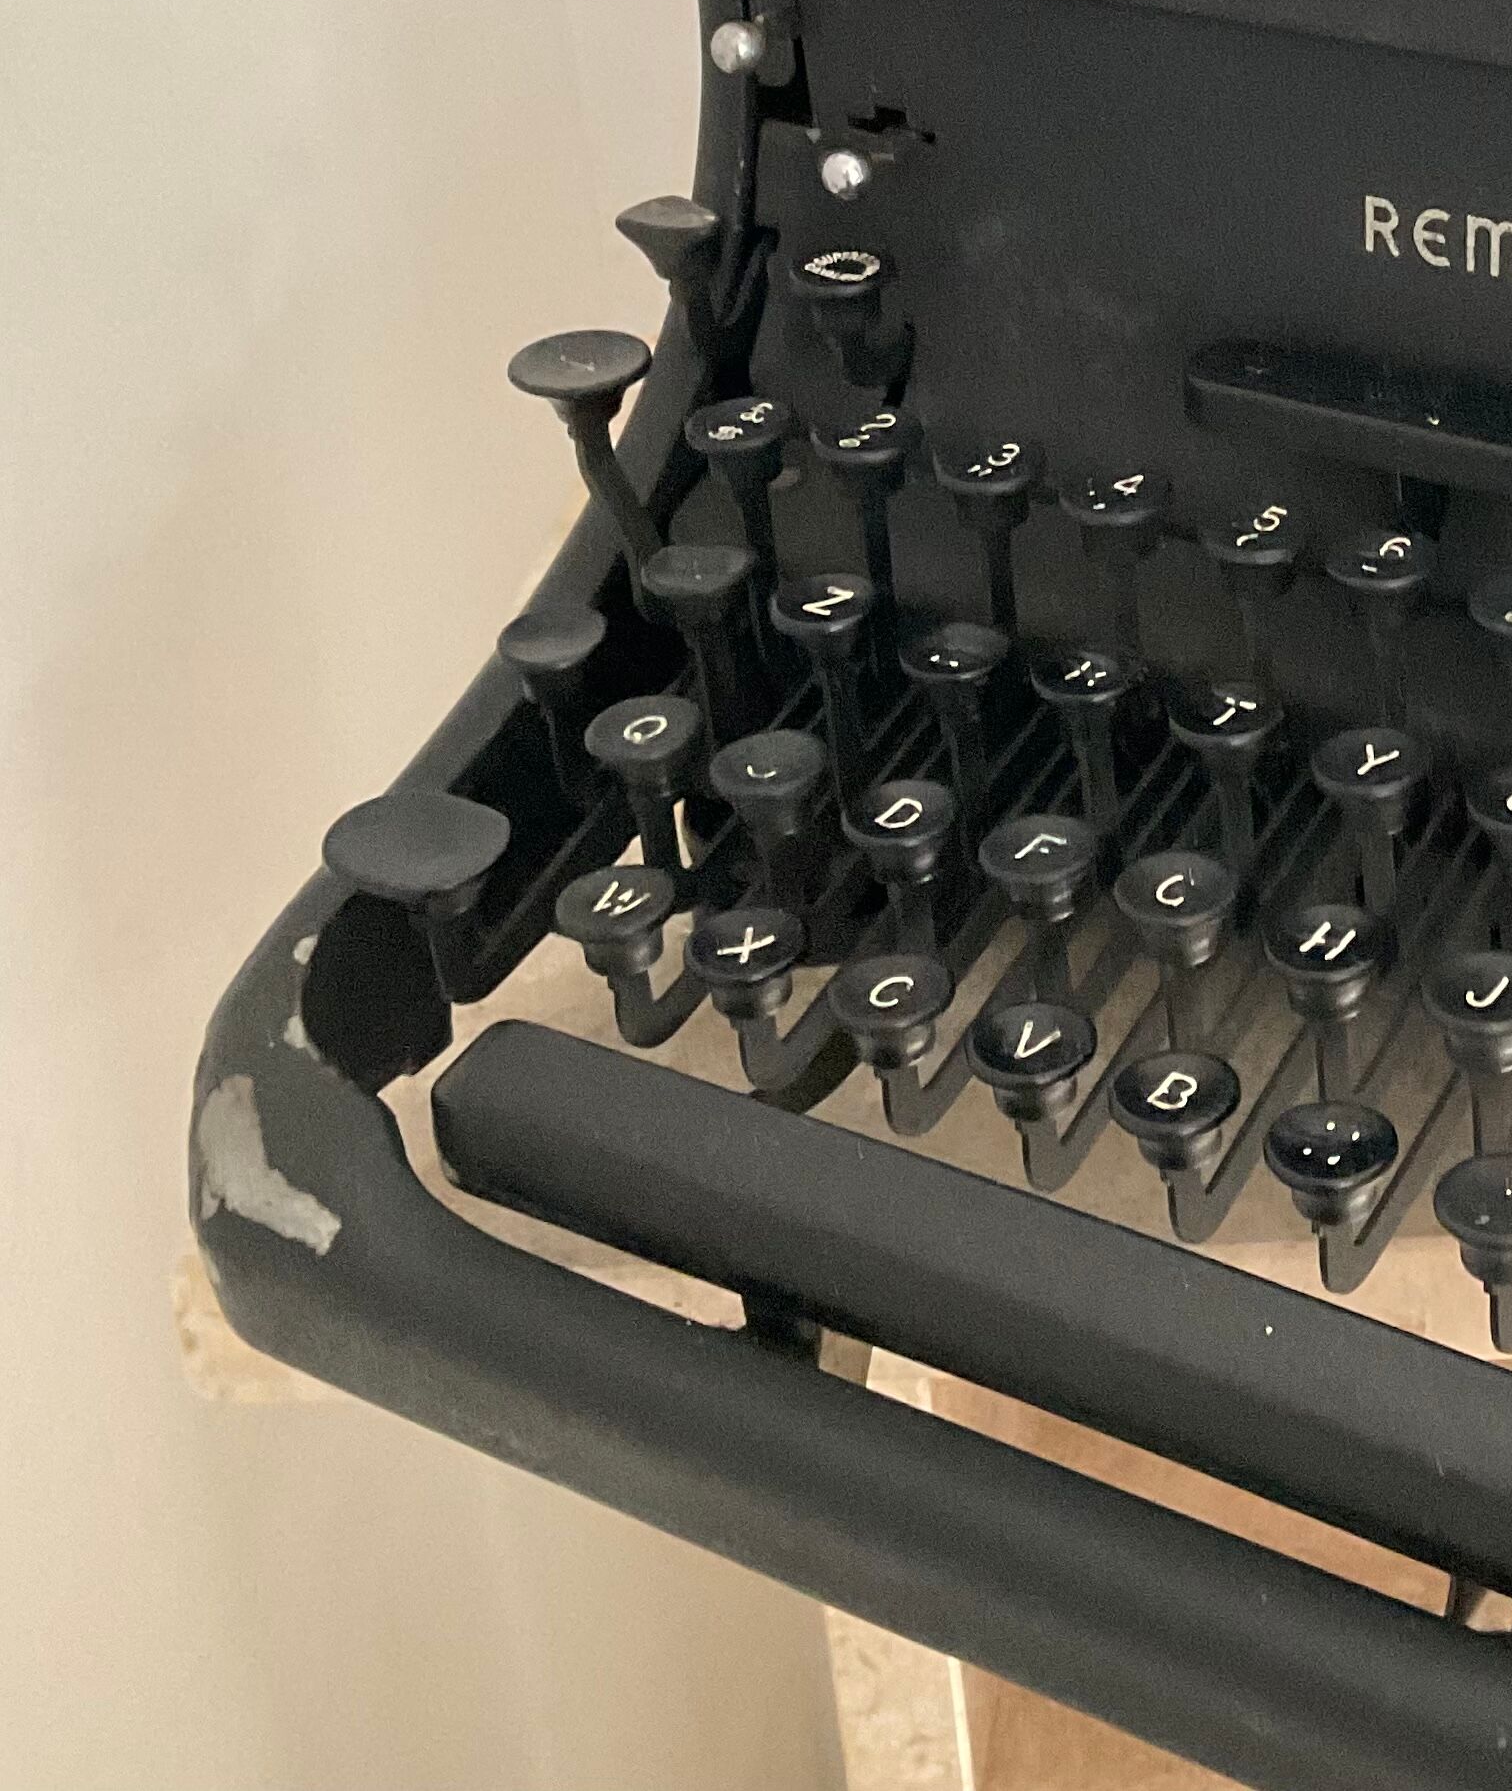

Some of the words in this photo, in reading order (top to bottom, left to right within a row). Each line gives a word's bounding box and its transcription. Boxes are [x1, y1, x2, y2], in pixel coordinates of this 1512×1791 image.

[861, 413, 897, 432] 2
[988, 443, 1020, 467] 3
[1113, 474, 1144, 496] 4
[1253, 505, 1288, 532] 5
[1379, 536, 1412, 558] 6
[802, 585, 855, 616] Z
[1357, 743, 1400, 776] Y
[874, 797, 923, 829] D
[716, 926, 776, 964] X
[1299, 920, 1357, 961] H
[869, 975, 914, 1008] C
[1465, 975, 1510, 1008] J
[1013, 1020, 1061, 1059] V
[1146, 1071, 1198, 1110] B
